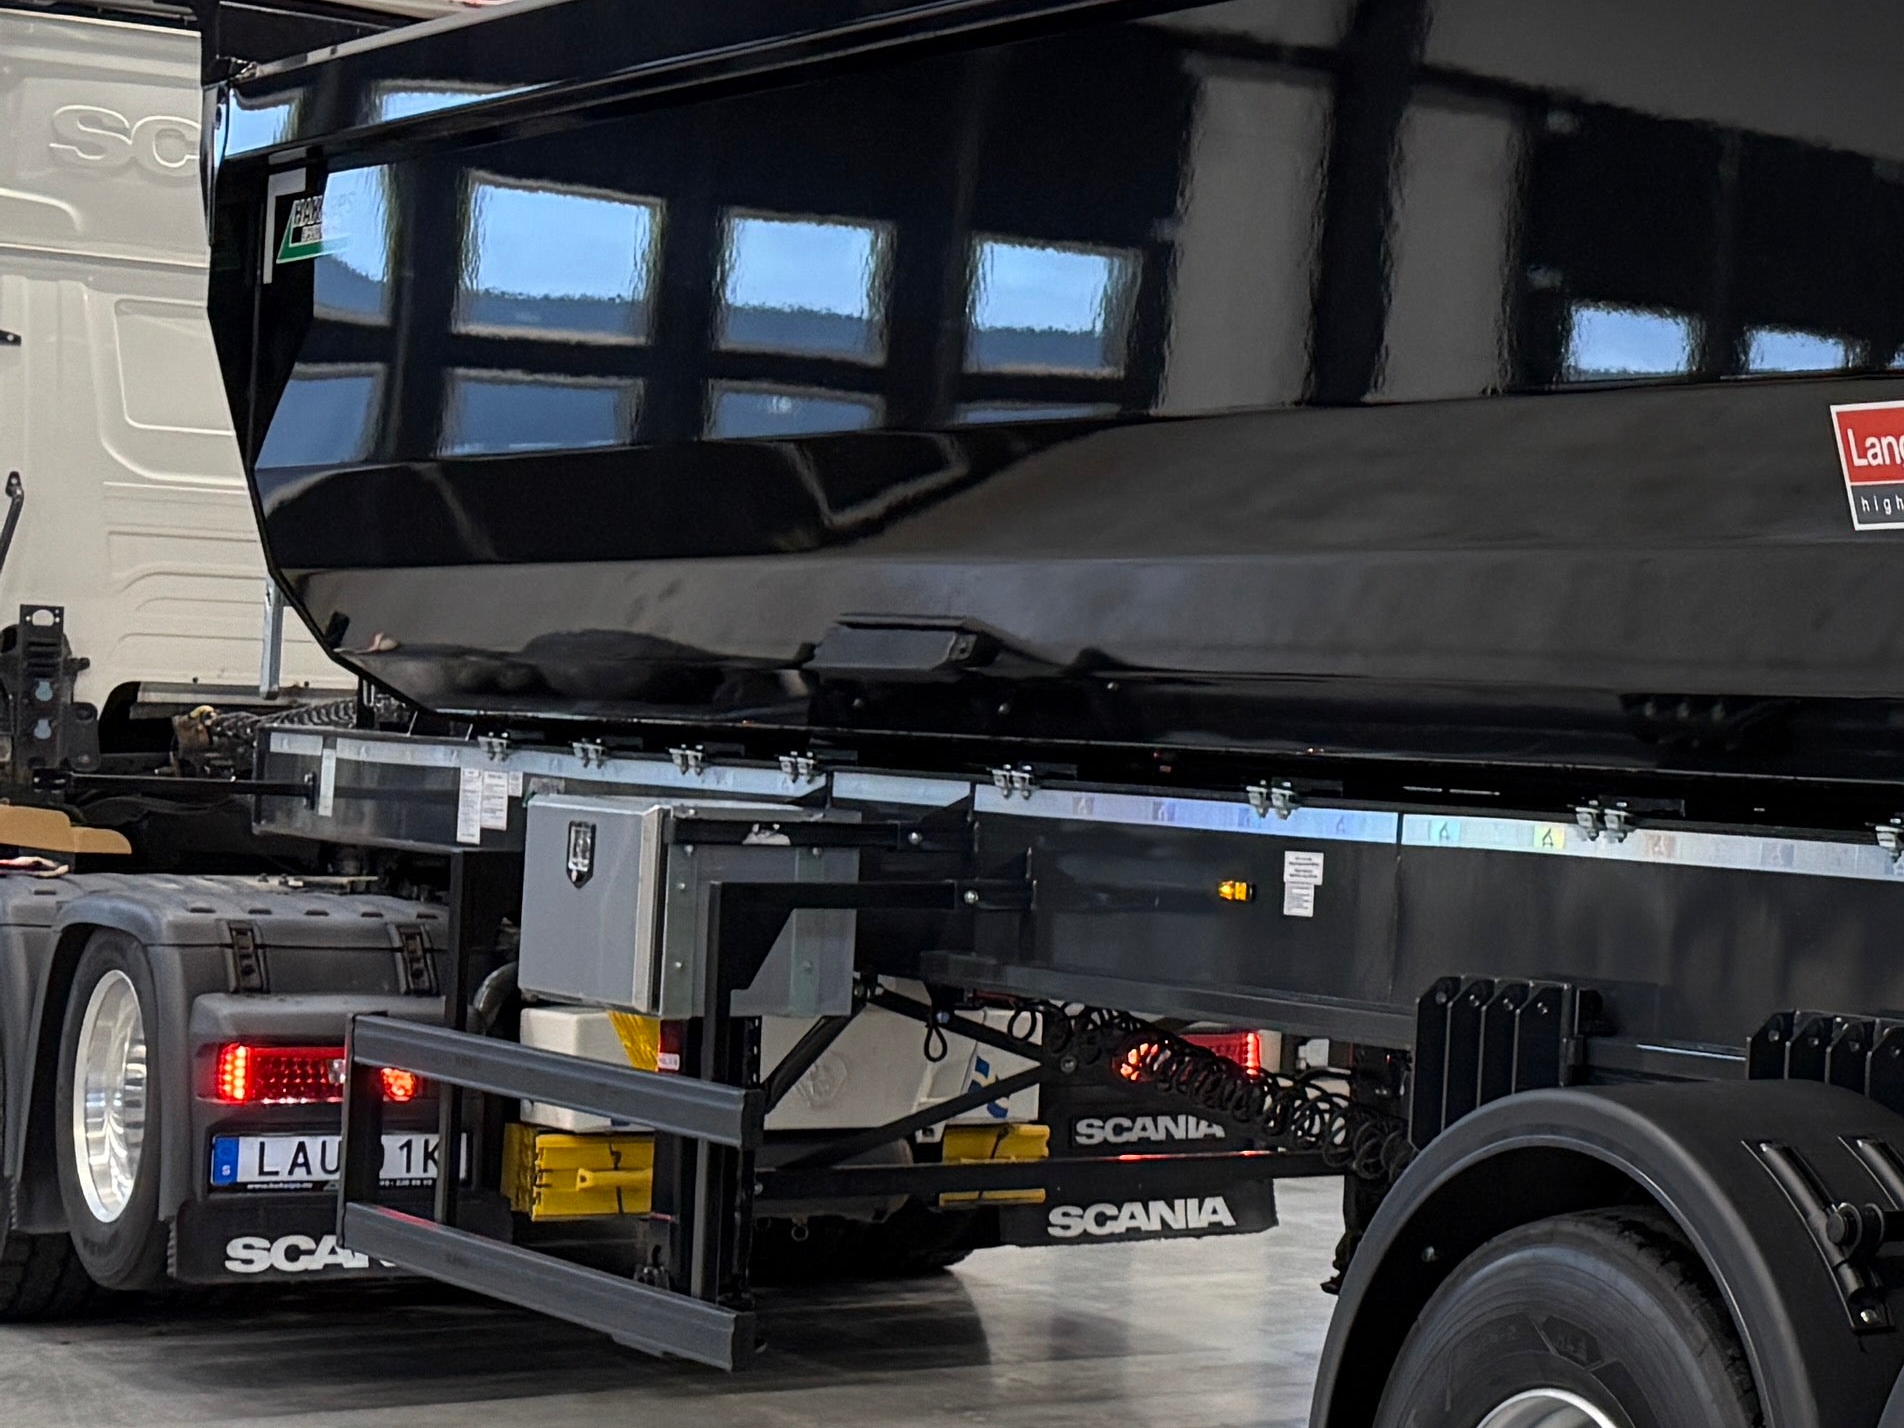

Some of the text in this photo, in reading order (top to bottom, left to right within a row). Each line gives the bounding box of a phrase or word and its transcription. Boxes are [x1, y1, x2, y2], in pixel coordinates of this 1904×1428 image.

[1860, 495, 1904, 516] high
[1075, 1114, 1225, 1145] SCANIA
[258, 1140, 342, 1177] LAU
[1047, 1196, 1236, 1237] SCANIA
